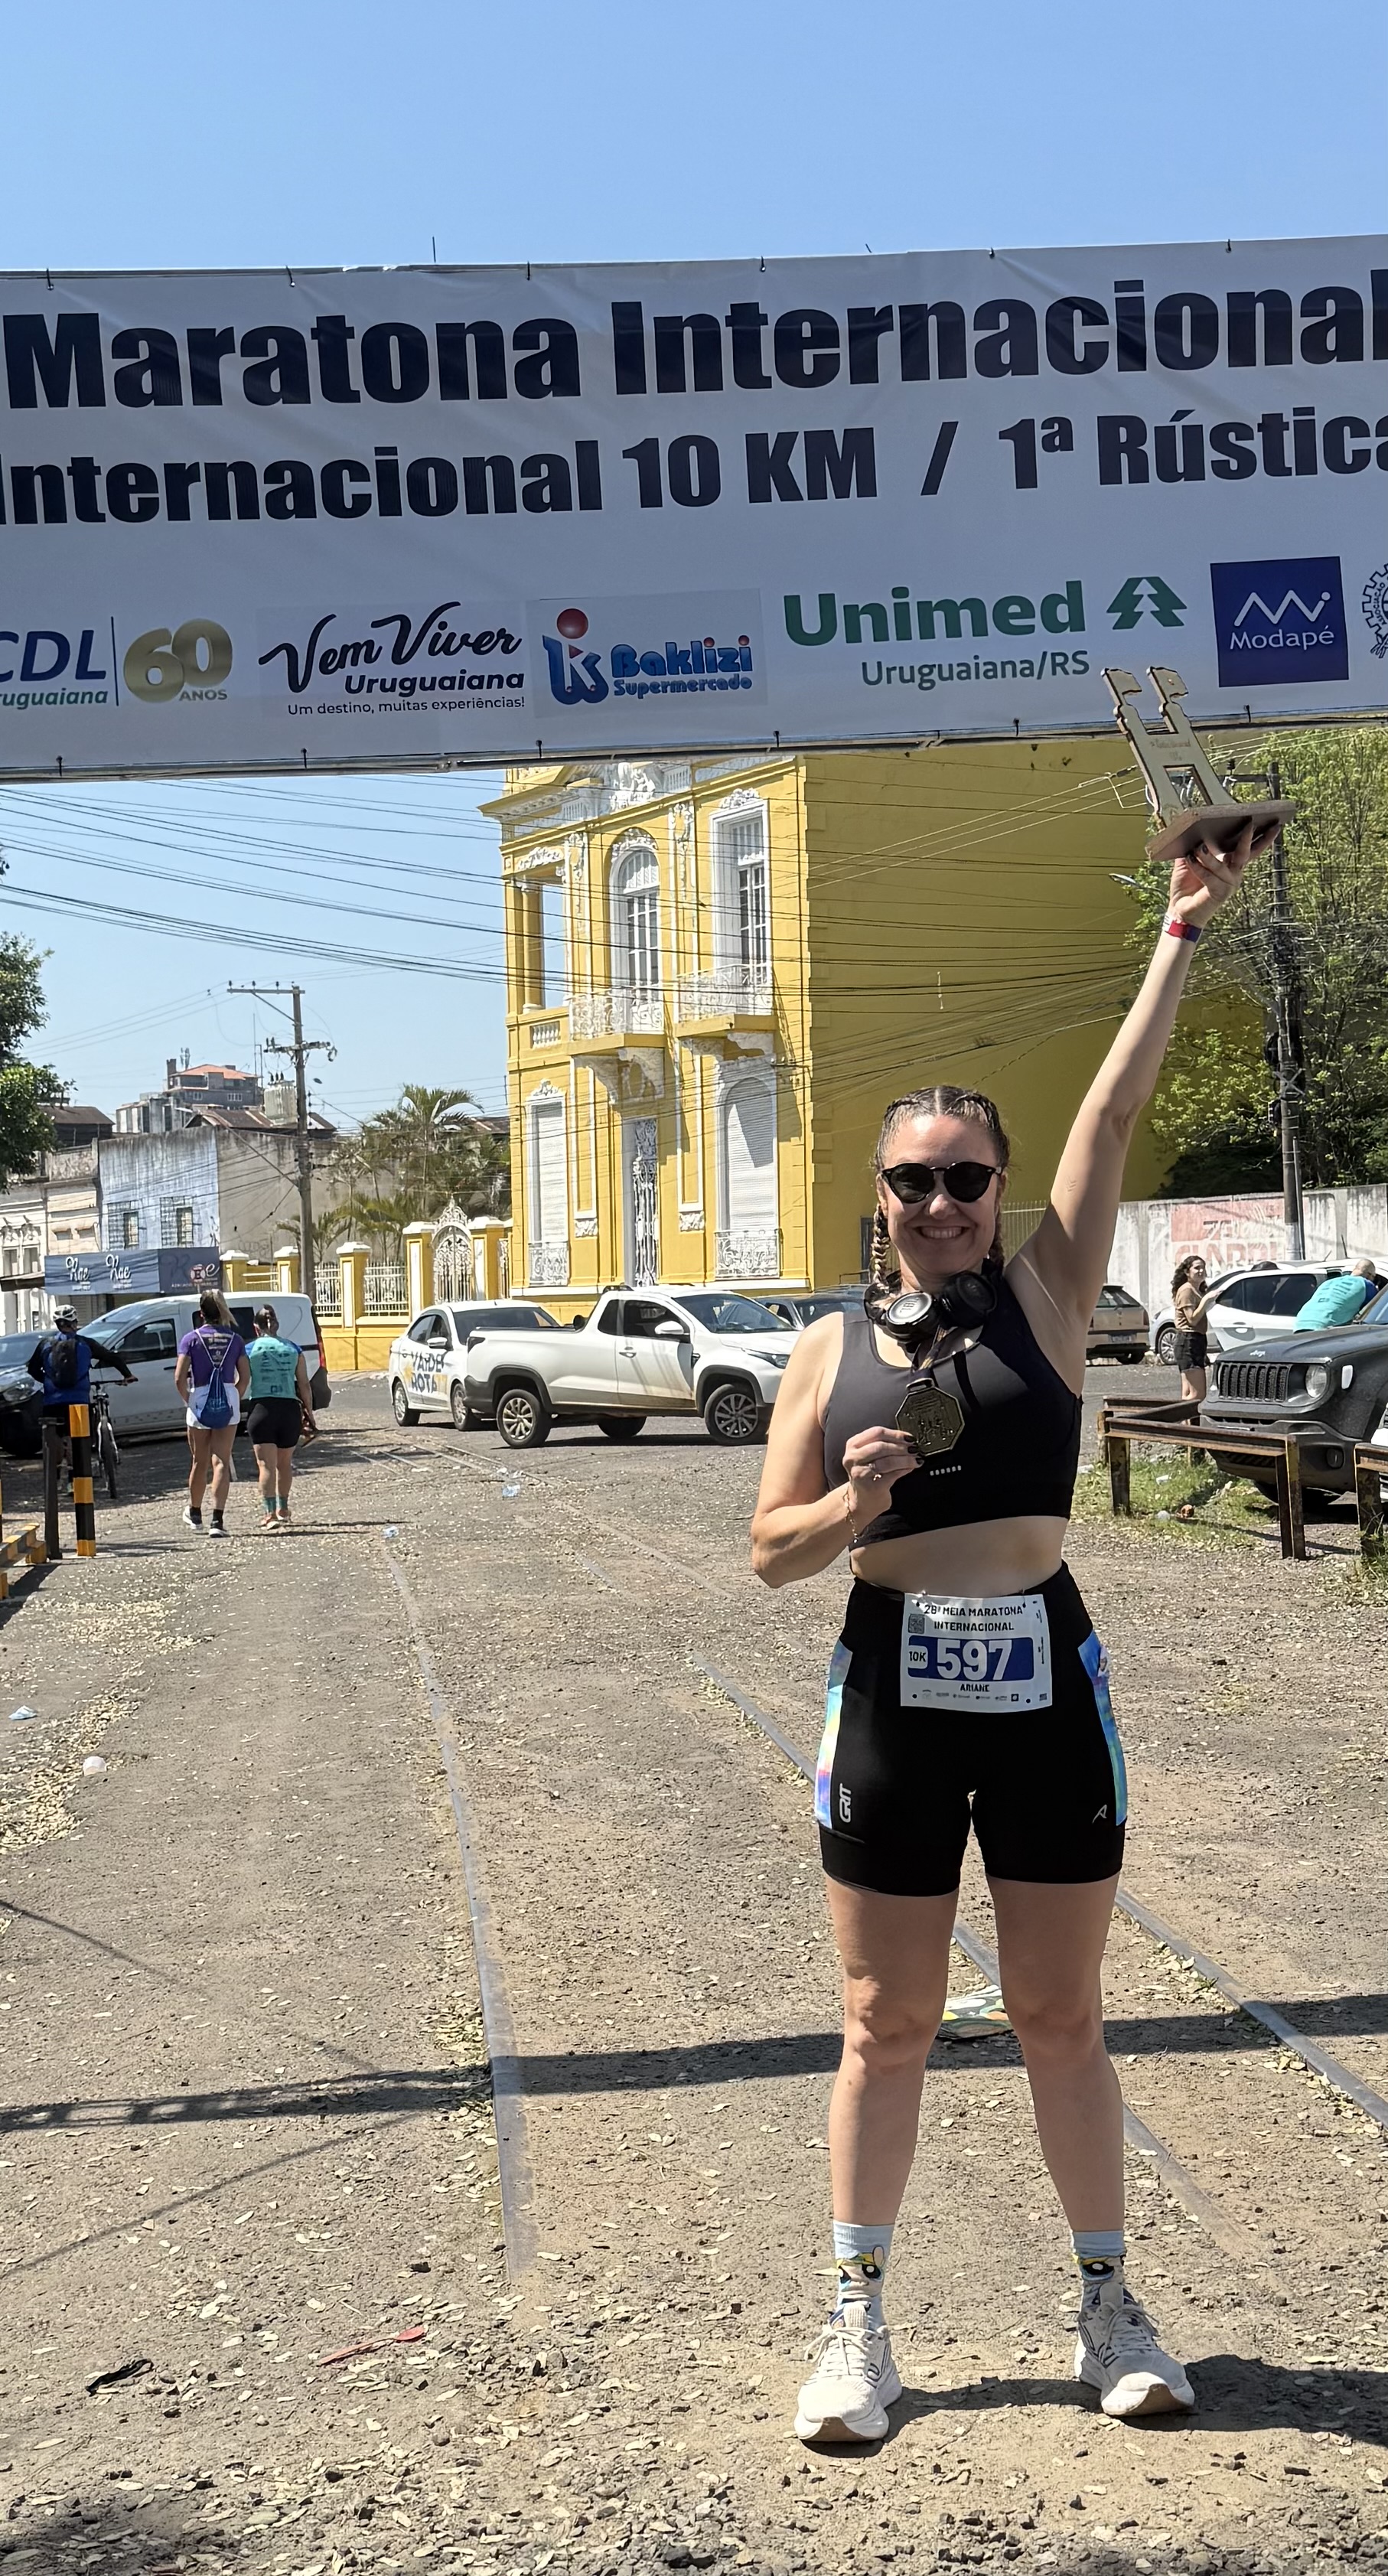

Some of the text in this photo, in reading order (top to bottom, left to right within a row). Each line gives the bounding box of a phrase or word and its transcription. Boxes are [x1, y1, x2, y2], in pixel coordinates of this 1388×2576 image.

[3, 269, 1388, 409] Maratona Internacional
[0, 406, 1388, 525] nternacional 10 KM / 1ª Rústic
[784, 581, 1086, 646] Unimed
[259, 602, 523, 693] Vem Viver
[1230, 624, 1334, 651] Modapé
[123, 618, 233, 703] 60
[611, 634, 753, 678] Baklizi
[862, 651, 1090, 691] Uruguaiana/RS
[0, 688, 108, 709] uguaiana
[179, 690, 227, 701] ANOS
[345, 669, 524, 697] Uruguaiana
[614, 674, 752, 699] Supermercado
[288, 696, 525, 715] Um destino, muitas experiências!
[933, 1621, 1015, 1632] INTERNACIONAL
[943, 1606, 966, 1616] MEIA
[968, 1605, 1024, 1617] MARATONA
[909, 1639, 1012, 1681] 10K 597
